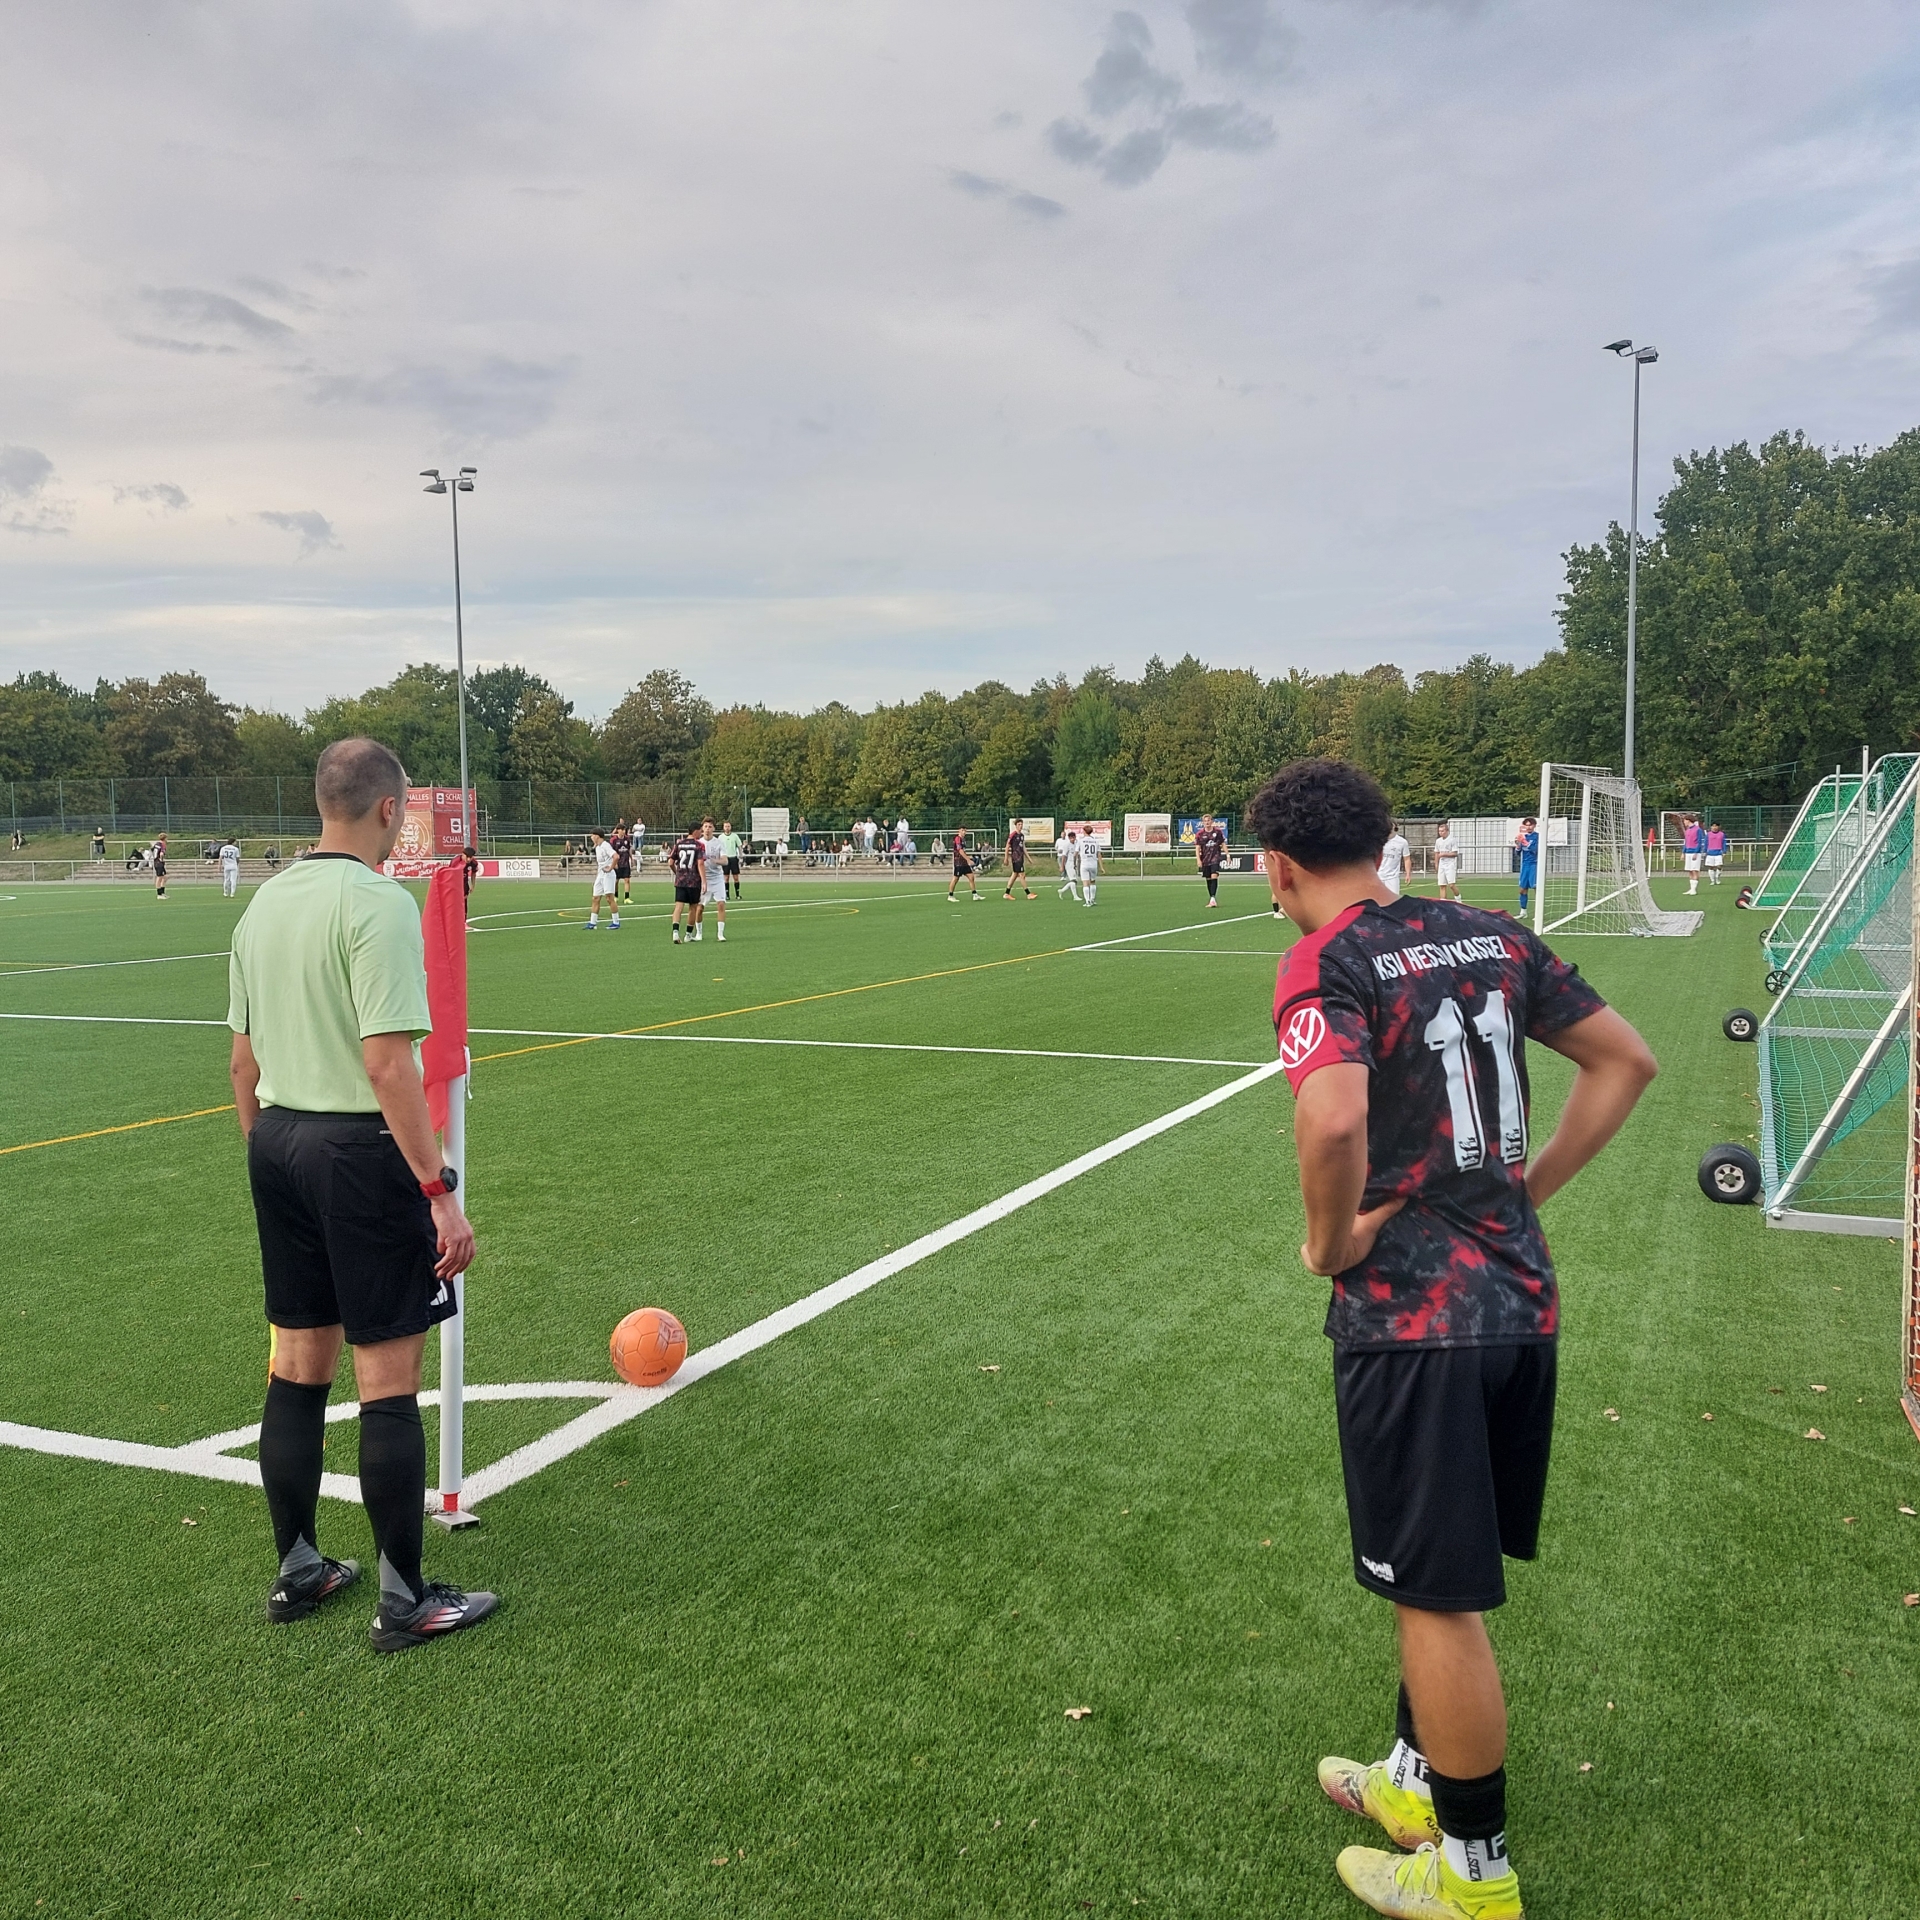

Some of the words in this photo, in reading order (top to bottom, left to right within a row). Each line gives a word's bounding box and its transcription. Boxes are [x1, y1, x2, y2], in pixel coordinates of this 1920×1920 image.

[224, 850, 234, 860] 32
[1084, 844, 1096, 855] 20
[505, 860, 532, 870] ROSE
[678, 849, 696, 869] 27
[1371, 951, 1408, 981] KSV
[1448, 935, 1512, 965] KASSEL
[1424, 990, 1527, 1173] 11
